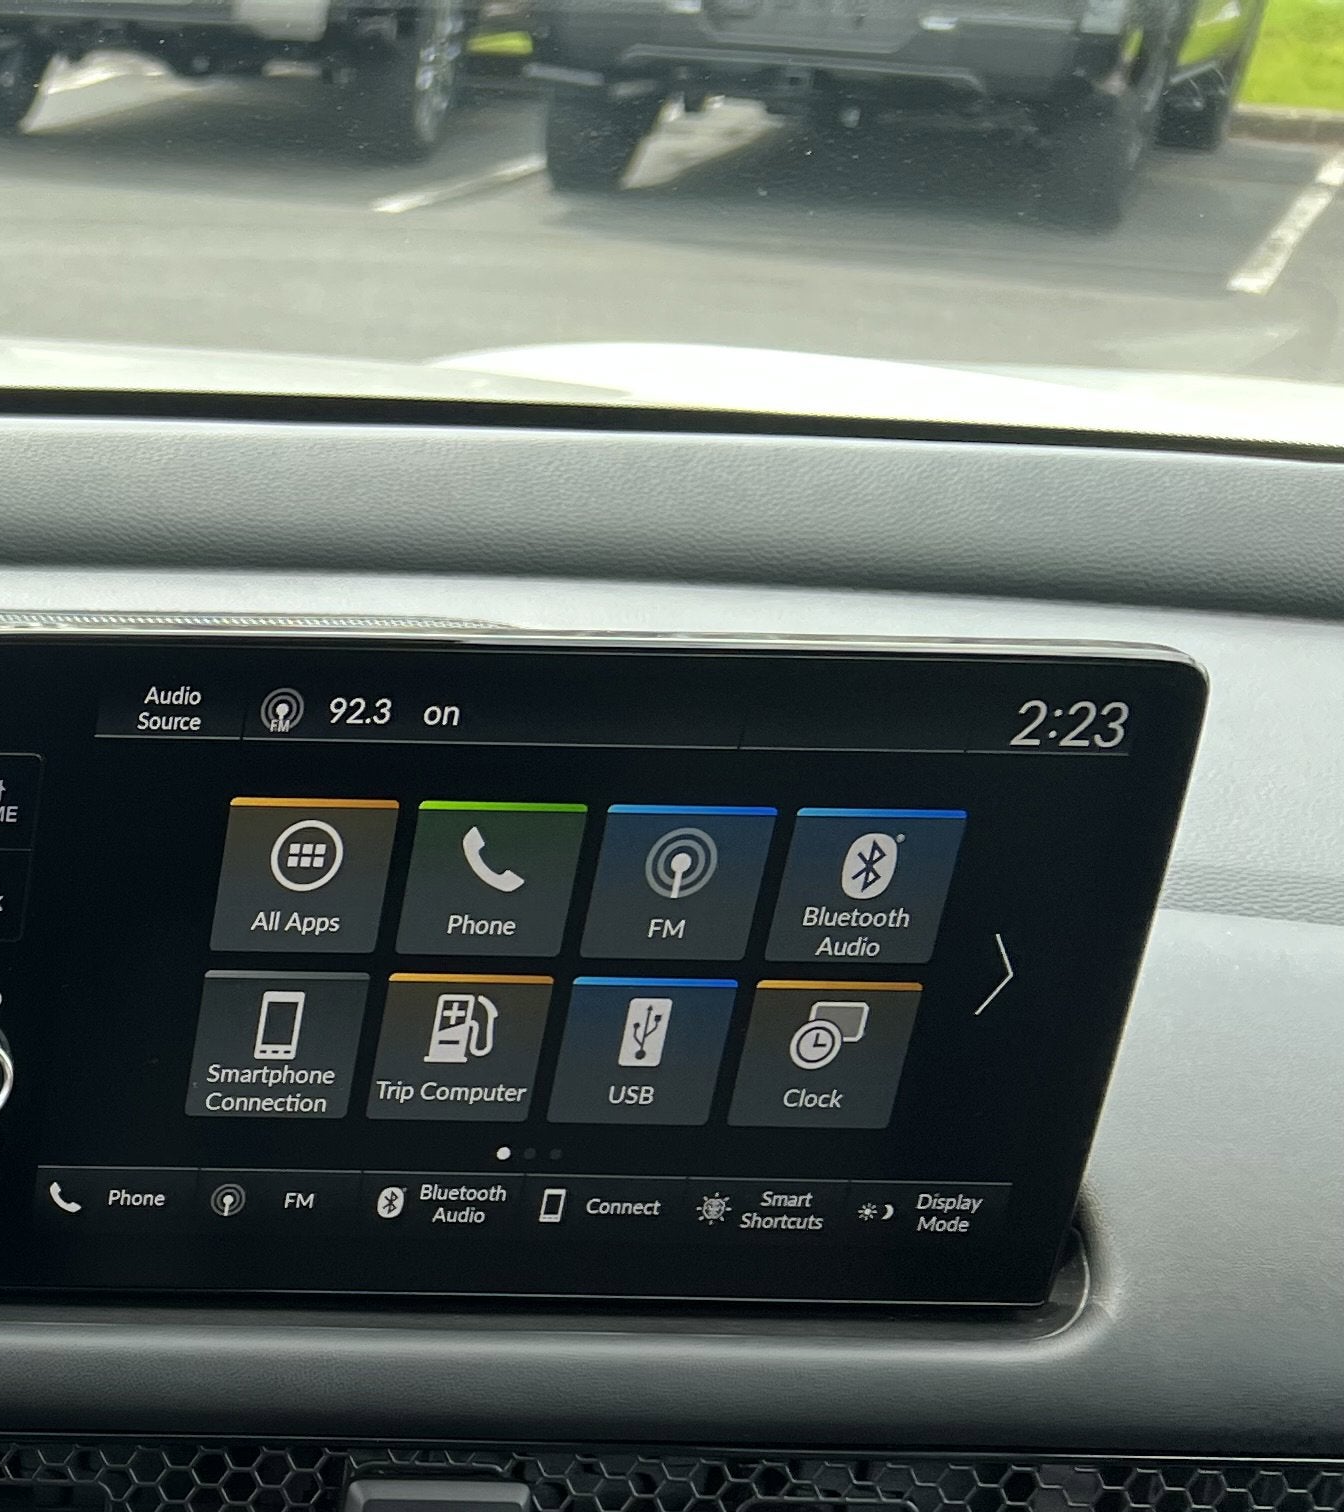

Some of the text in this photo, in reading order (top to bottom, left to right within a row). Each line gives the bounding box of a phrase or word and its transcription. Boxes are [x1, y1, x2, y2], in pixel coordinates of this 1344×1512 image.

[144, 686, 202, 705] Audio
[137, 712, 202, 731] Source
[328, 698, 460, 726] 92.3 on
[269, 718, 290, 733] FM
[1010, 700, 1129, 748] 2:23
[250, 911, 340, 936] All Apps
[447, 915, 517, 936] Phone
[802, 907, 910, 929] Bluetooth
[647, 919, 686, 939] FM
[816, 936, 880, 957] Audio
[207, 1064, 336, 1086] Smartphone
[205, 1091, 327, 1114] Connection
[377, 1082, 526, 1105] Trip Computer
[608, 1085, 654, 1105] USB
[783, 1089, 843, 1109] Clock
[108, 1190, 165, 1206] Phone
[284, 1193, 315, 1209] FM
[419, 1183, 507, 1202] Bluetooth
[760, 1190, 813, 1208] Smart
[586, 1199, 660, 1216] Connect
[917, 1194, 983, 1214] Display
[432, 1207, 485, 1224] Audio
[739, 1212, 823, 1230] Shortcuts
[917, 1216, 969, 1232] Mode
